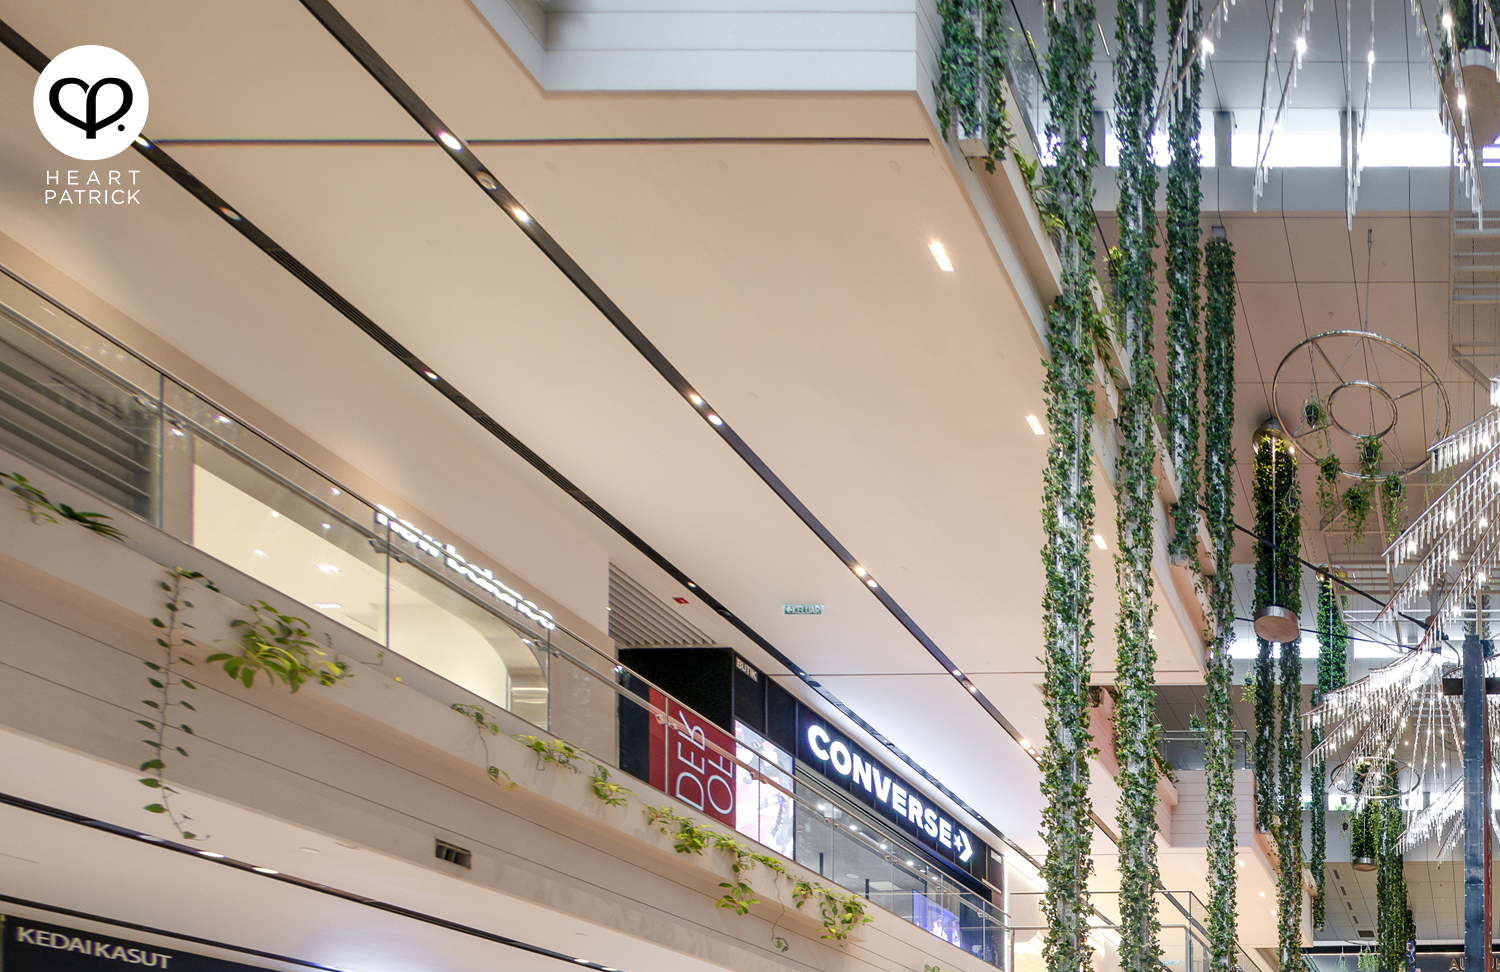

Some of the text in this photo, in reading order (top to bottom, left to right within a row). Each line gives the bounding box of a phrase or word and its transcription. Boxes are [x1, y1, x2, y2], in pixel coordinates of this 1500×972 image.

[792, 605, 821, 615] KELUAR
[736, 656, 758, 683] BUTIK
[808, 724, 952, 849] CONVERSE
[17, 926, 173, 969] KEDAI KASUT
